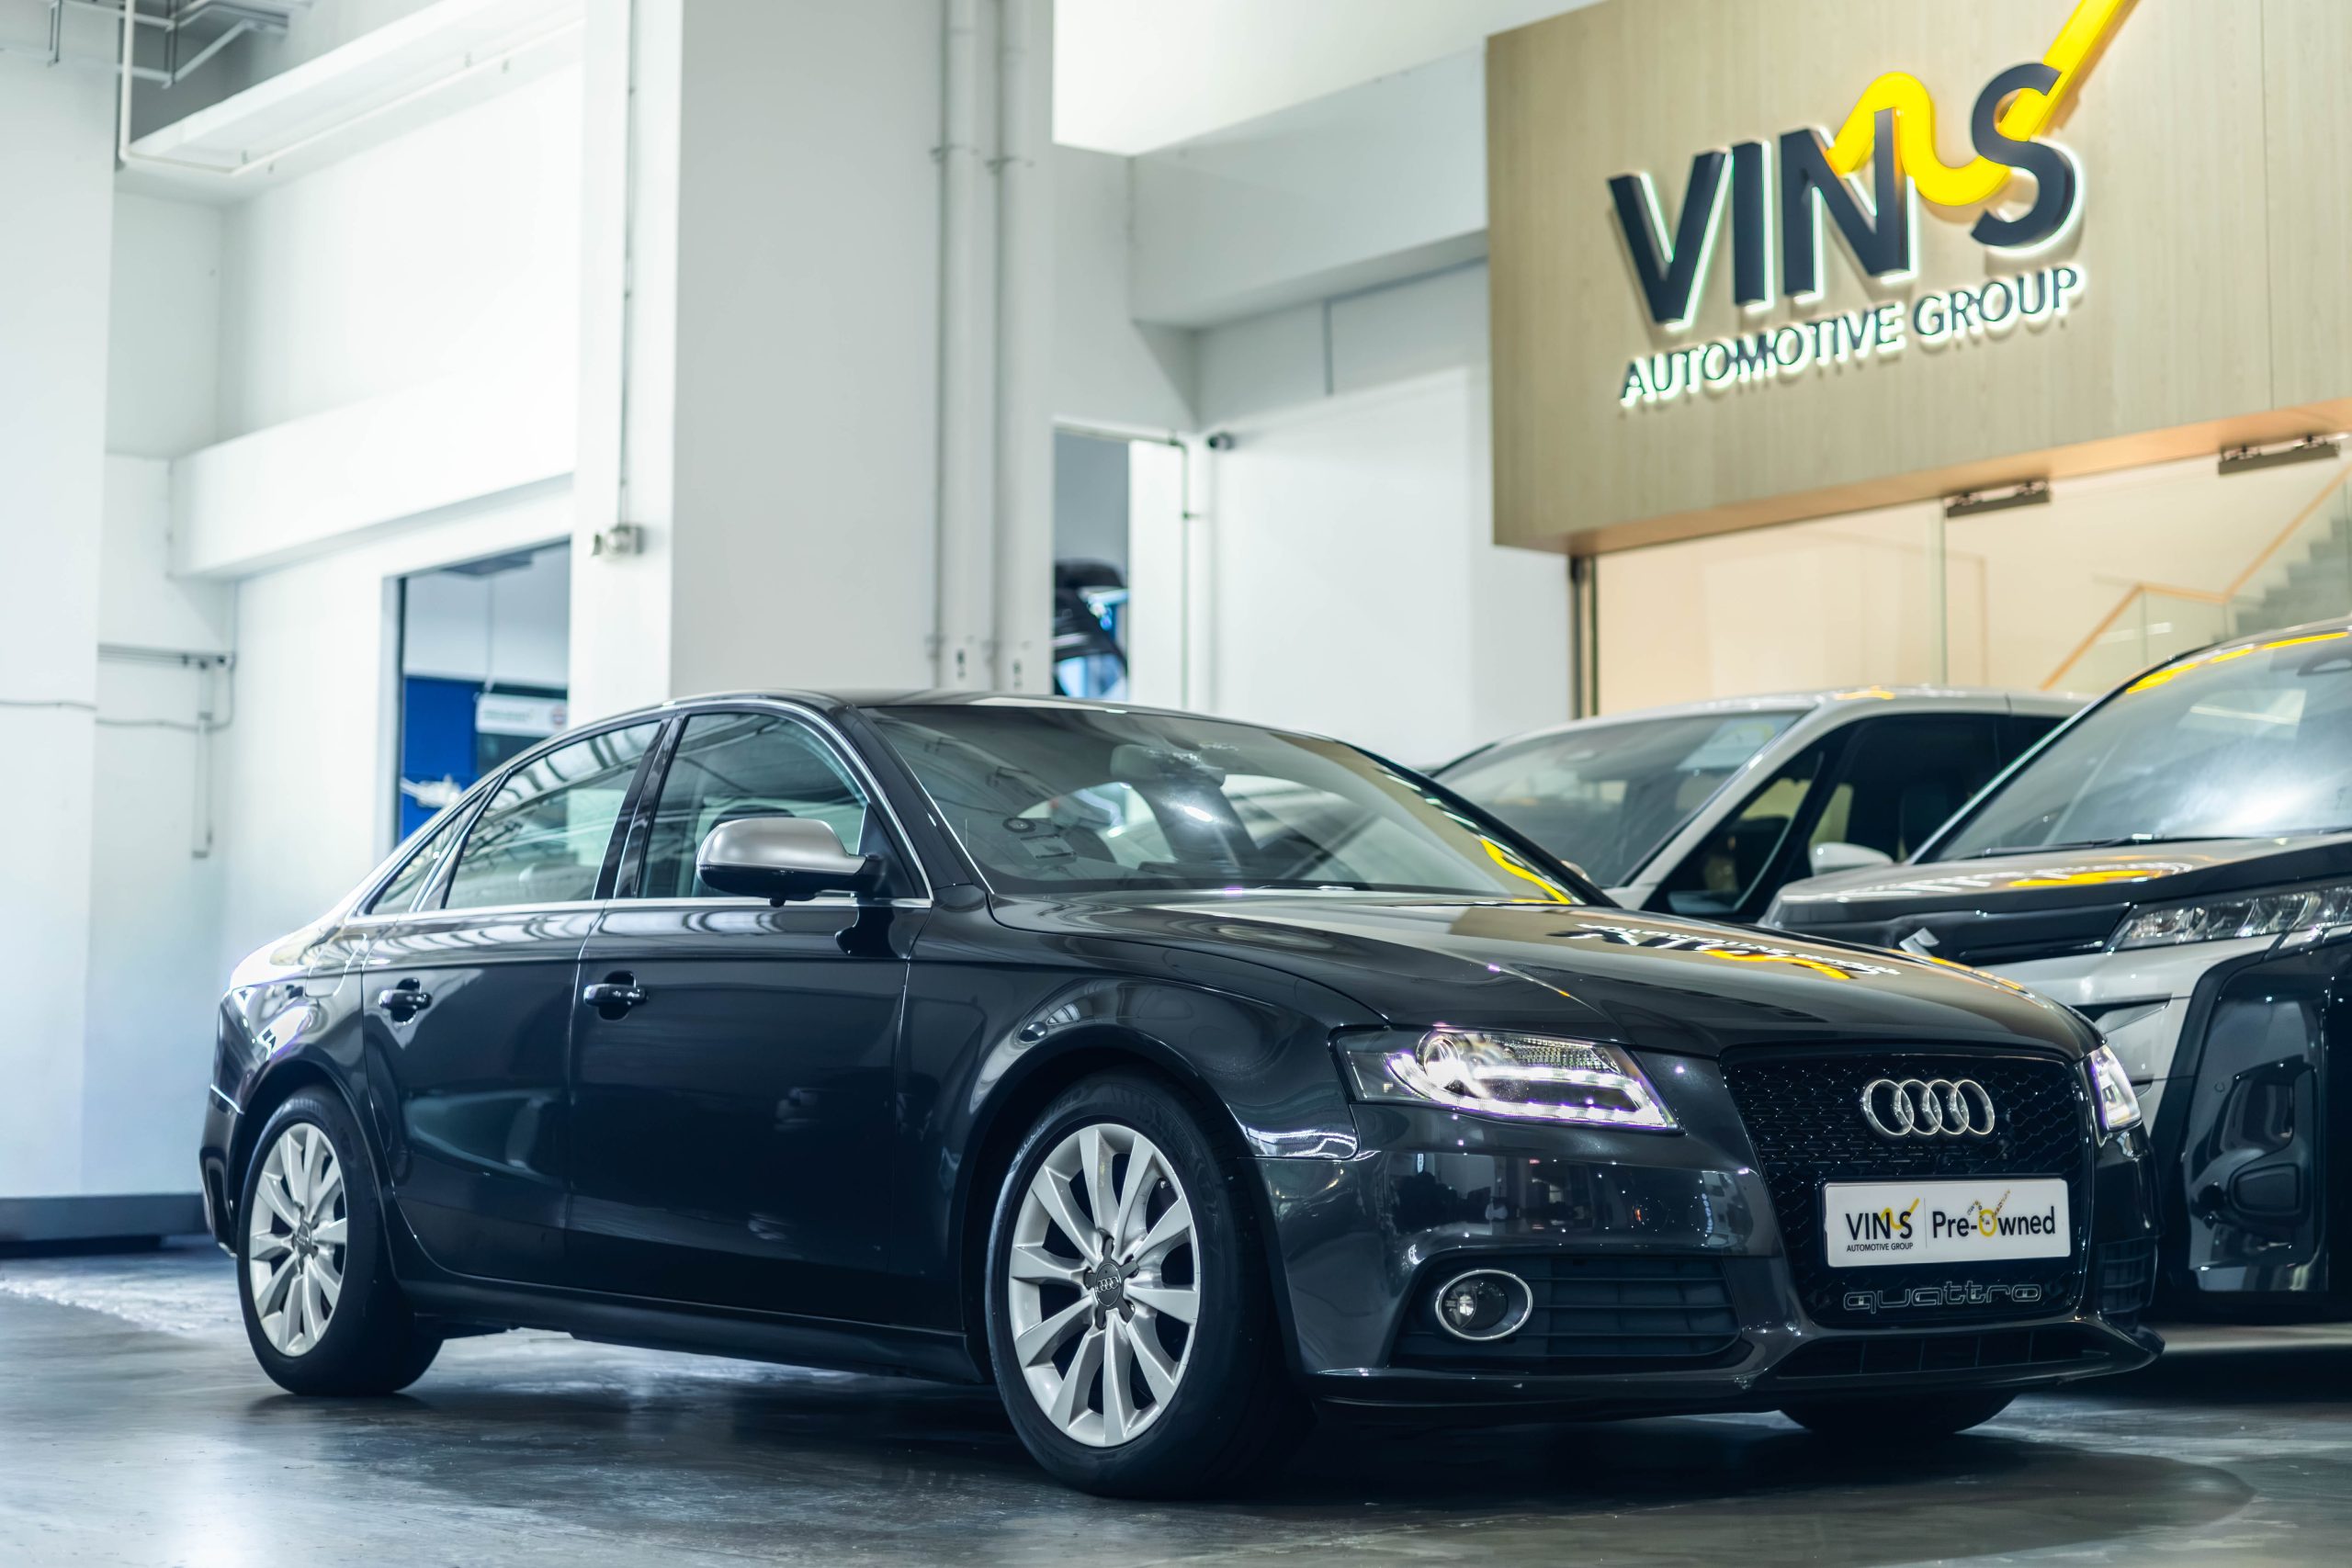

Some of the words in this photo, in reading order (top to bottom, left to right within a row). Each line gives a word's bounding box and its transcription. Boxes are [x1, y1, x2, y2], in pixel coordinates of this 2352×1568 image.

[1620, 302, 1905, 406] AUTOMOTIVE
[1912, 265, 2086, 347] GROUP
[1932, 1205, 2056, 1239] Pre-Owned
[1846, 1243, 1890, 1252] AUTOMOTIVE
[1891, 1242, 1914, 1251] GROUP
[1843, 1280, 2042, 1314] quattro
